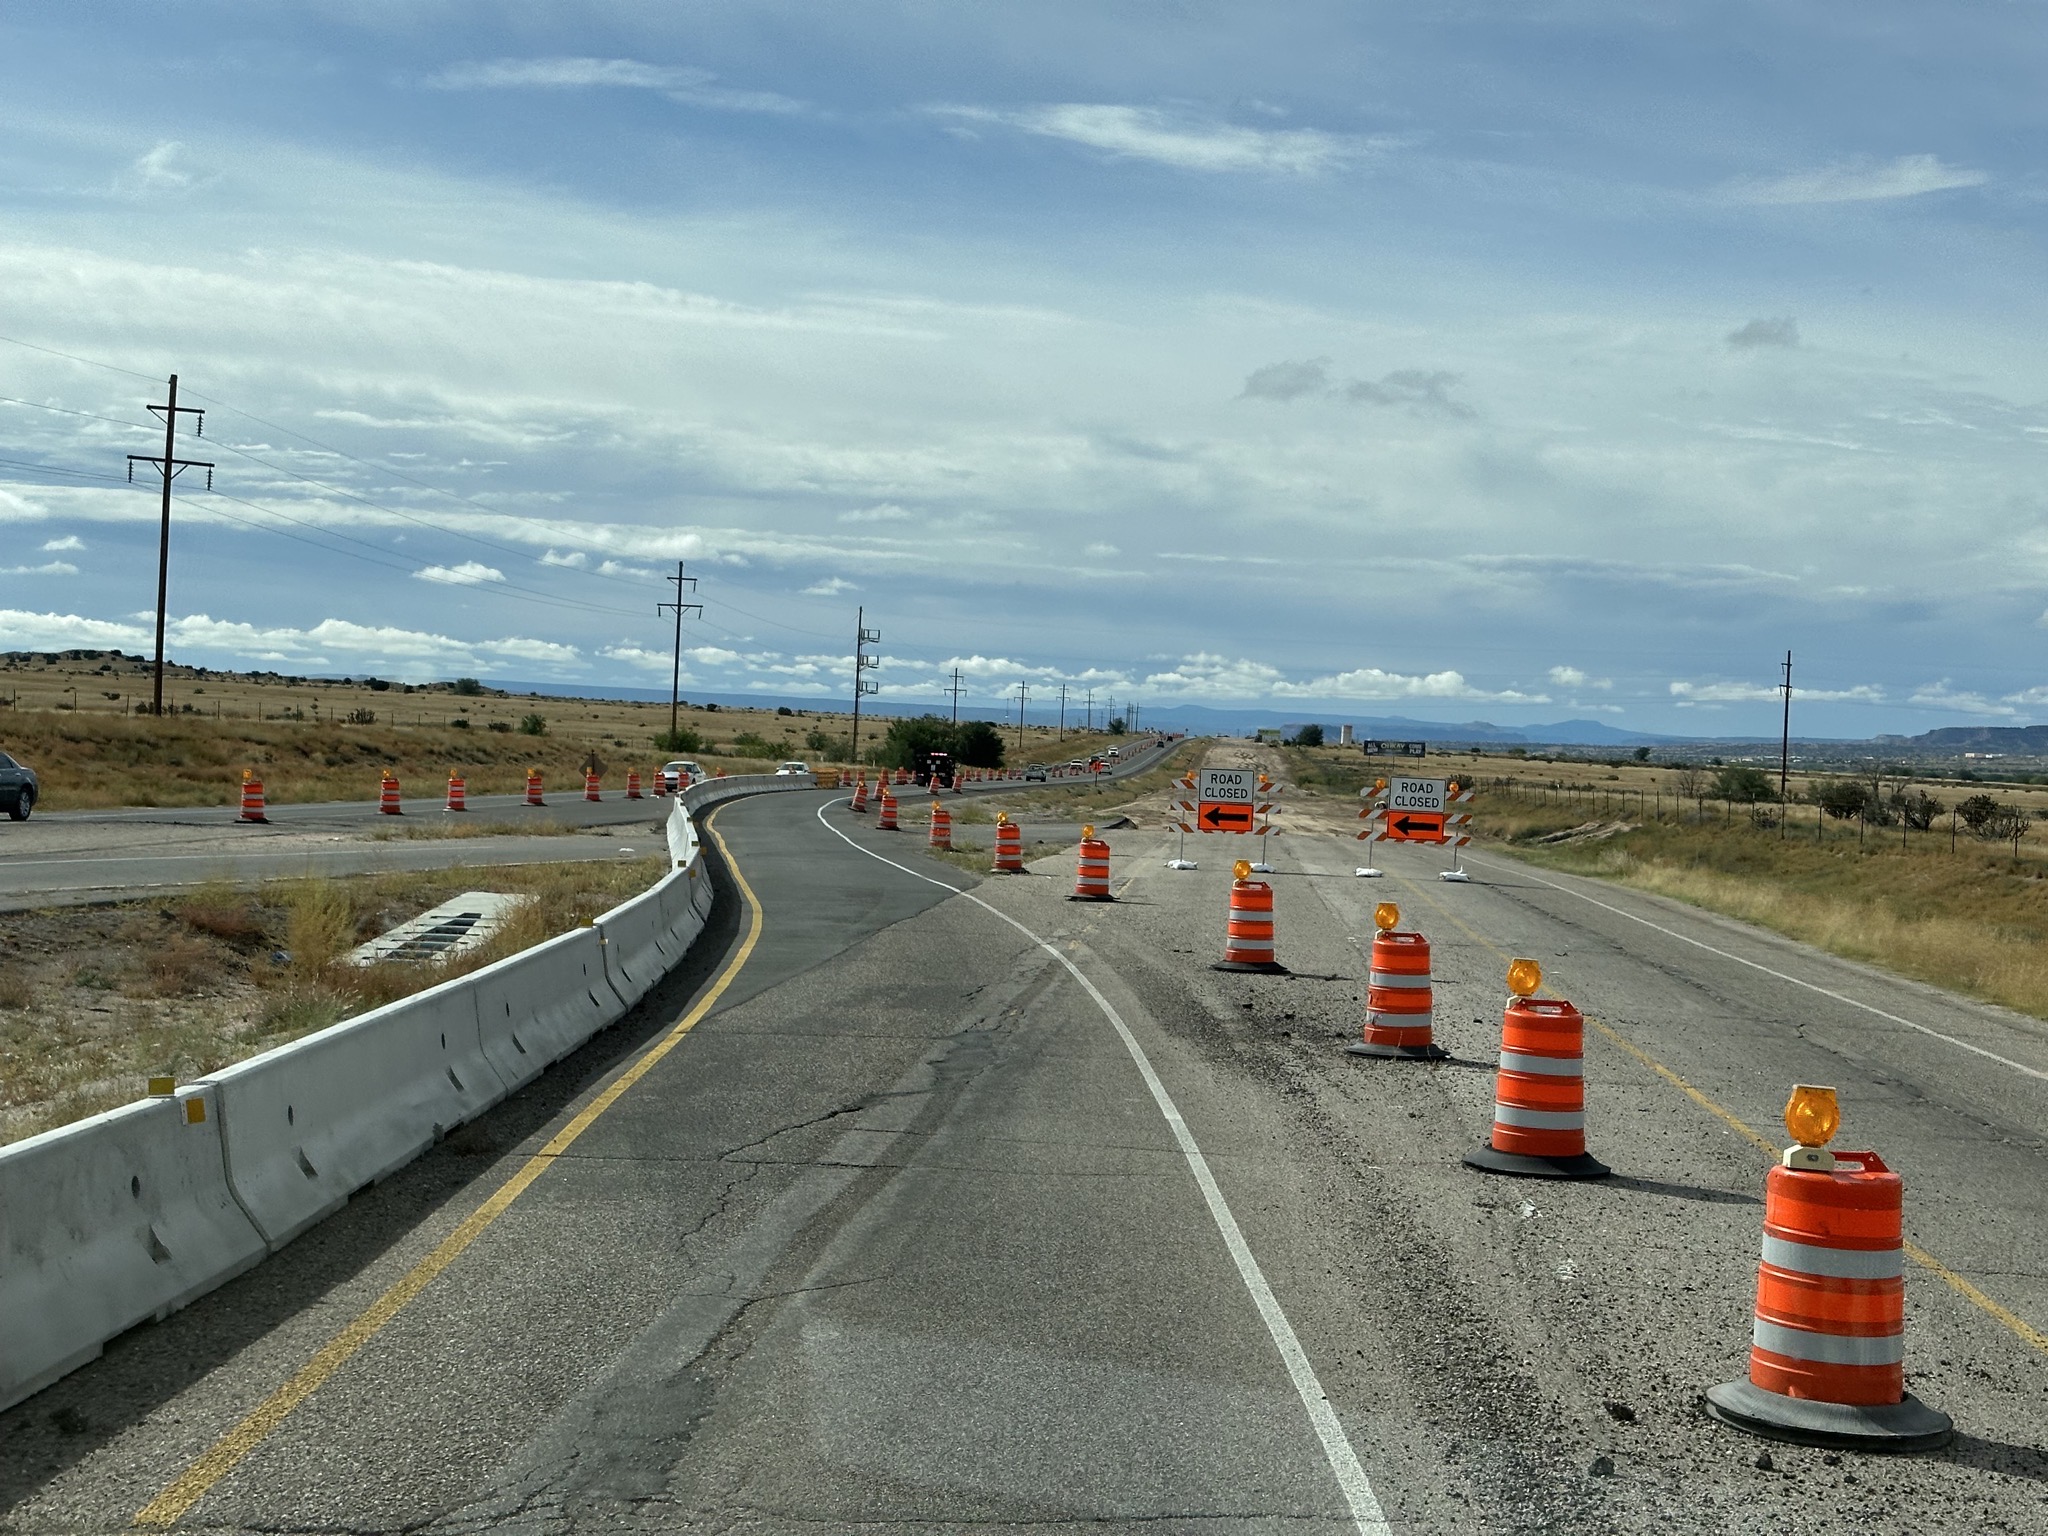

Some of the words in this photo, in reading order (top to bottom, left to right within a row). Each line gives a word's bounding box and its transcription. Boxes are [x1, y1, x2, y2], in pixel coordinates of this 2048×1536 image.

[1210, 773, 1242, 785] ROAD
[1204, 787, 1248, 799] CLOSED
[1401, 781, 1434, 794] ROAD
[1394, 795, 1440, 808] CLOSED
